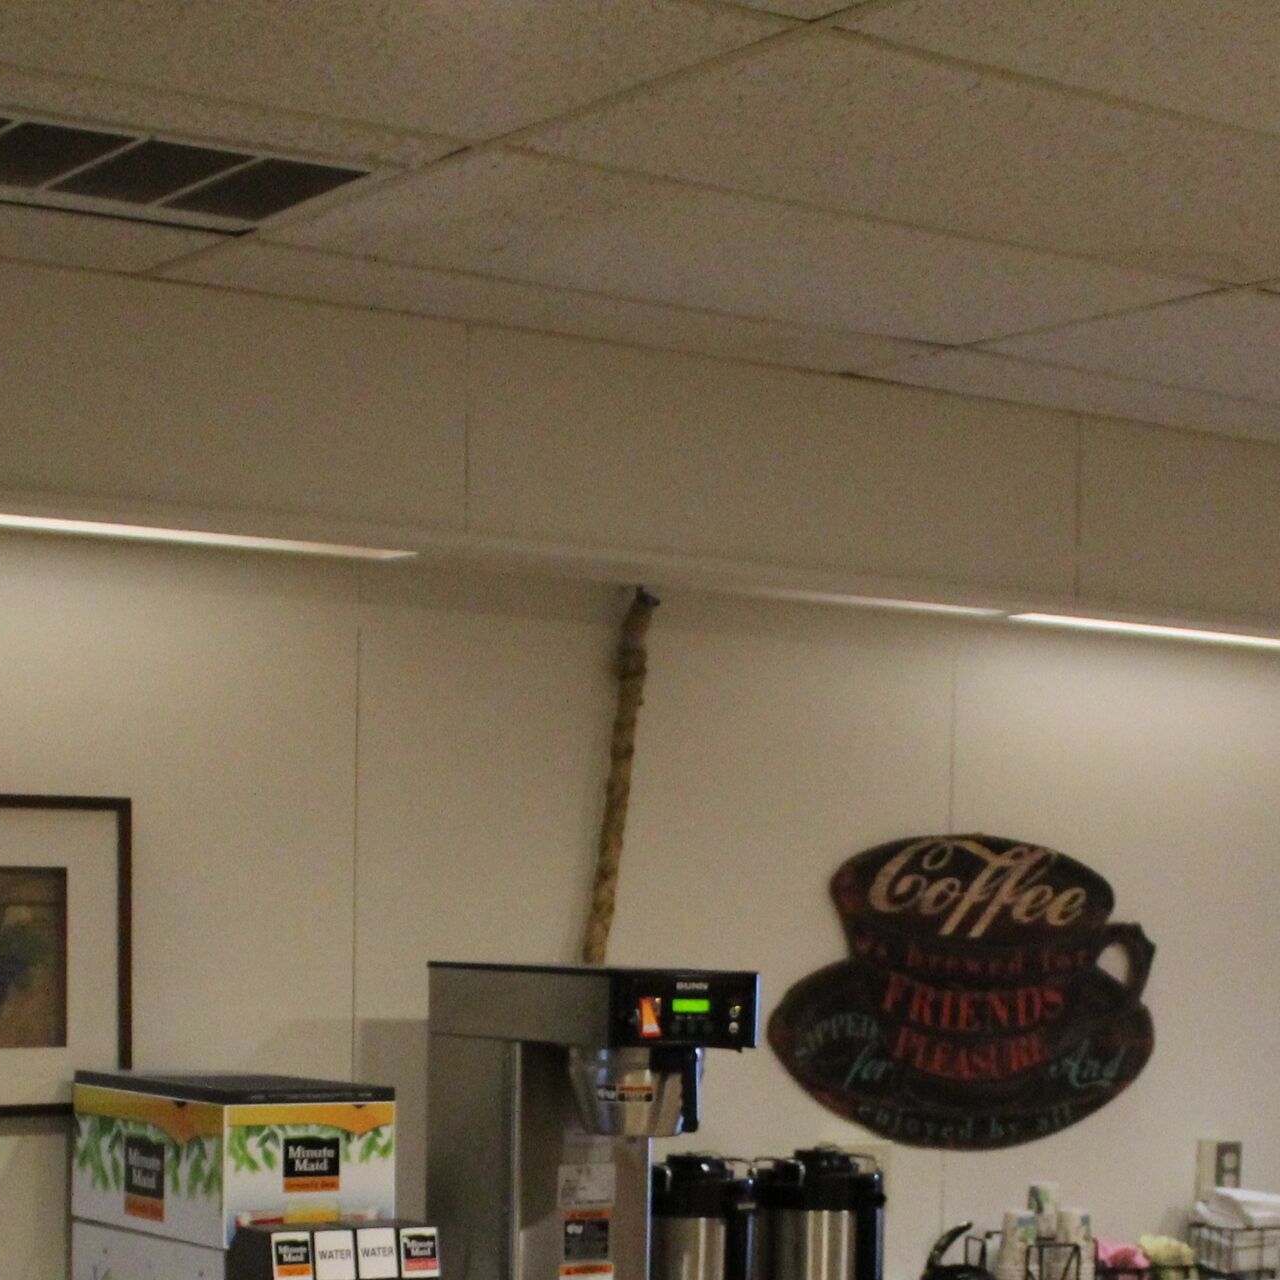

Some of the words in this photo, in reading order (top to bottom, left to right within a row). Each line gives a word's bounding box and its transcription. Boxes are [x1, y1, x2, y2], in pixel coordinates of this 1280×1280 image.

[867, 836, 1088, 939] Coffee
[881, 970, 1066, 1032] FRIENDS
[794, 1011, 880, 1058] SIPPED
[893, 1026, 1047, 1081] PLEASURE
[842, 1039, 894, 1091] for
[1048, 1038, 1127, 1090] And
[858, 1104, 974, 1143] enjoyed
[128, 1146, 161, 1171] Minute
[288, 1144, 335, 1159] Minute
[294, 1157, 329, 1172] Maid
[131, 1167, 157, 1189] Maid
[318, 1249, 352, 1260] WATER
[360, 1246, 394, 1258] WATER
